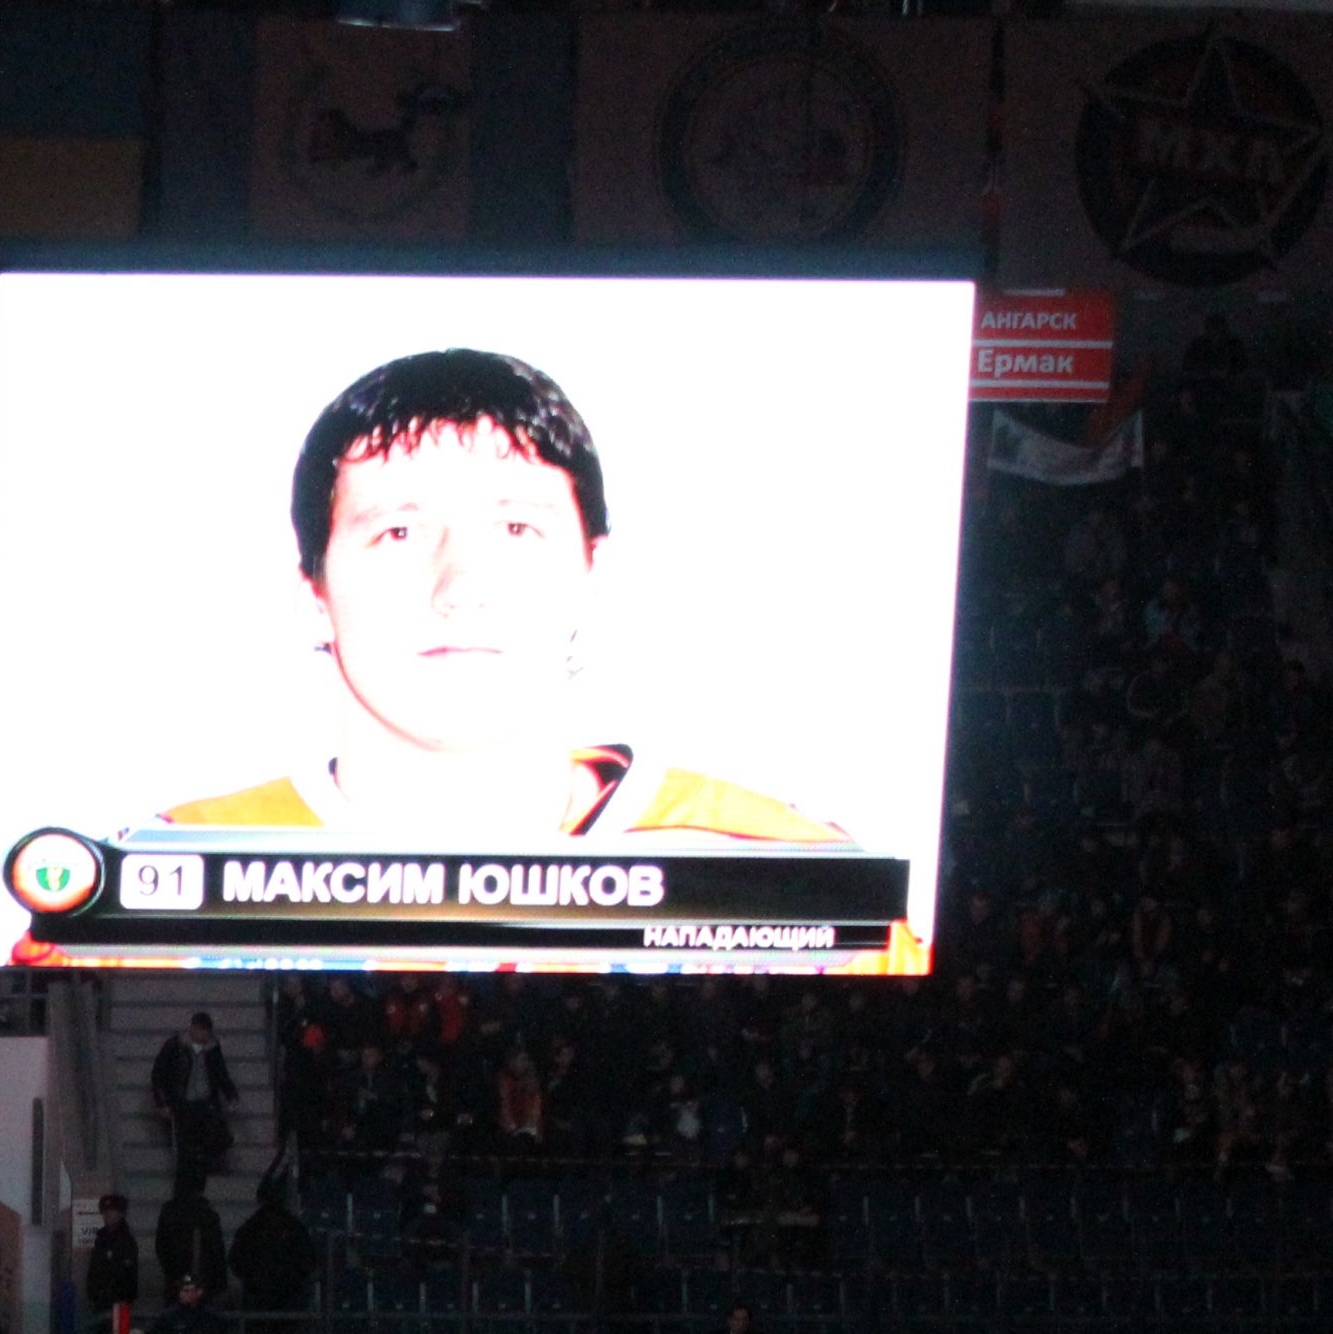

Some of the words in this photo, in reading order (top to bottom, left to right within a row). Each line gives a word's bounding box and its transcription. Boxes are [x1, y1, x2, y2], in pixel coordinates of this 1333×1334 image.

[981, 311, 1077, 330] АНГАРСК
[977, 349, 1075, 378] Ермак
[138, 864, 187, 896] 91
[223, 861, 445, 904] МАКСИМ
[459, 863, 665, 907] ЮШКОВ
[643, 924, 834, 951] НАПАДАЮЩИЙ
